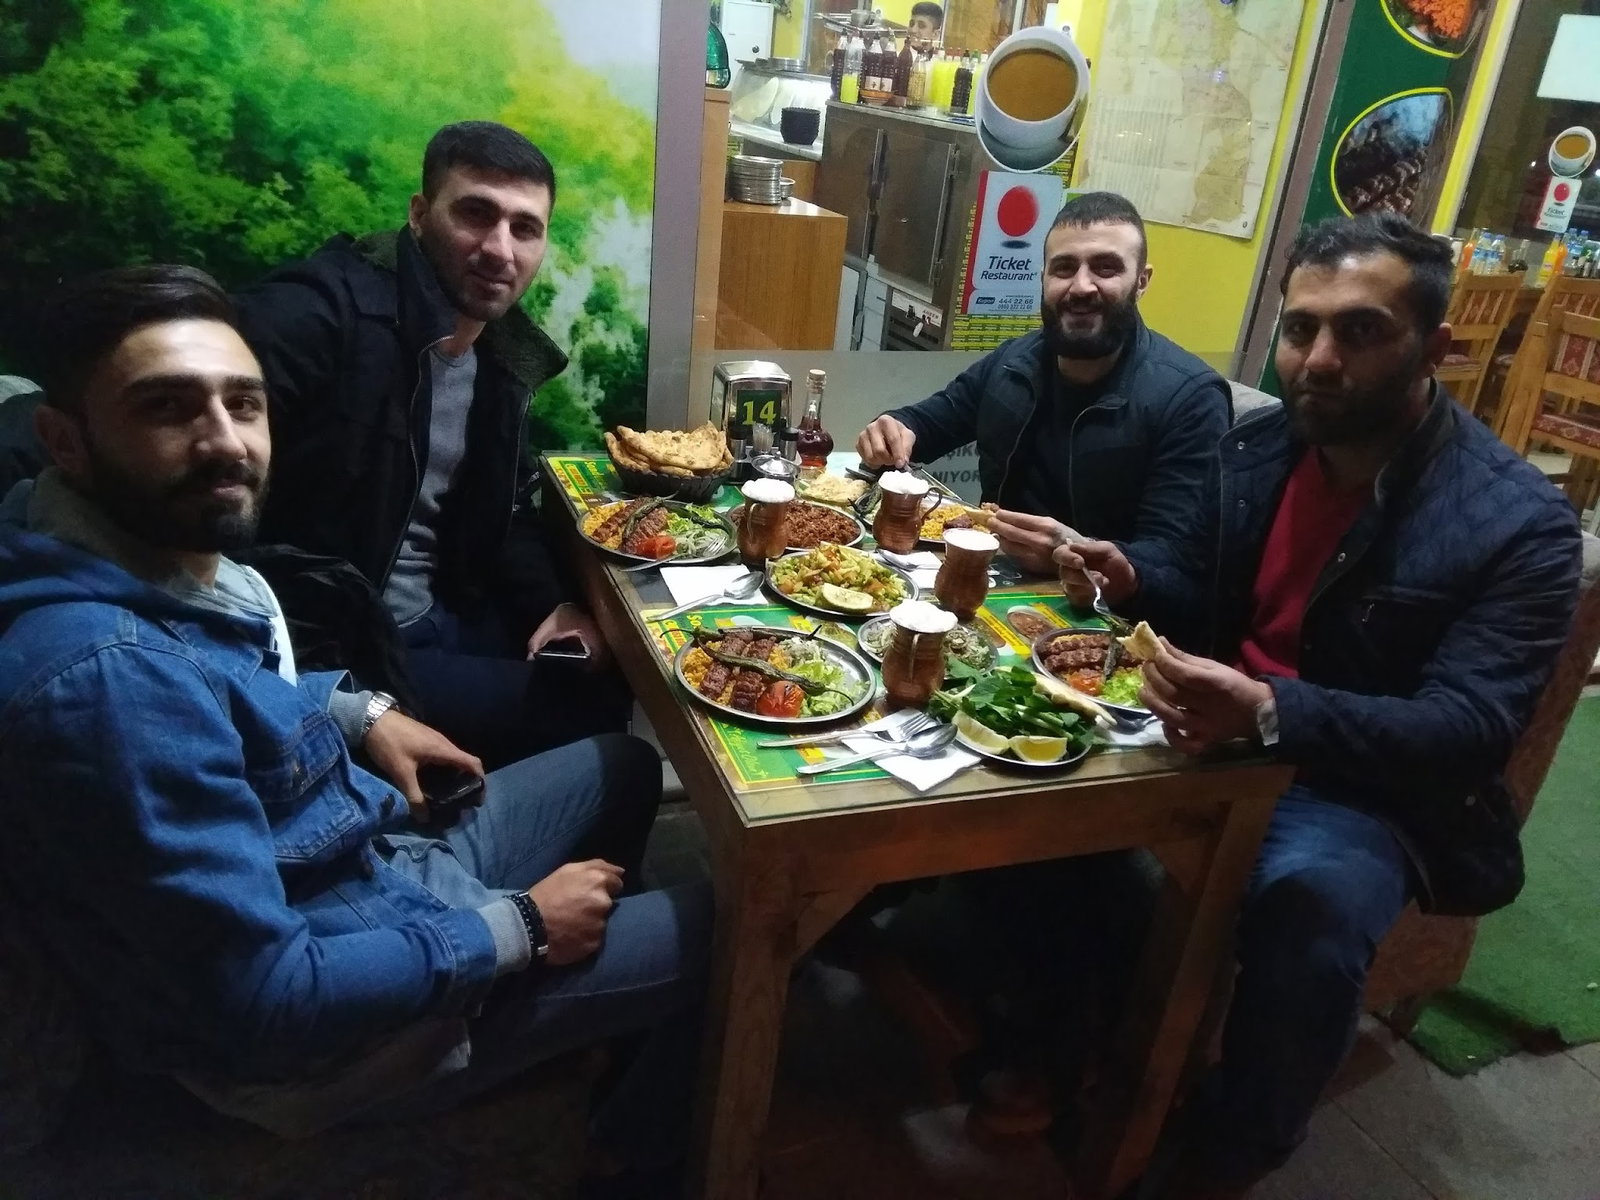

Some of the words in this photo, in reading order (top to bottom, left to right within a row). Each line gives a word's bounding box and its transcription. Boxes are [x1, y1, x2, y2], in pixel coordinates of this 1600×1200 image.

[988, 256, 1032, 270] Ticket
[980, 271, 1034, 281] Restaurant
[742, 401, 777, 425] 14
